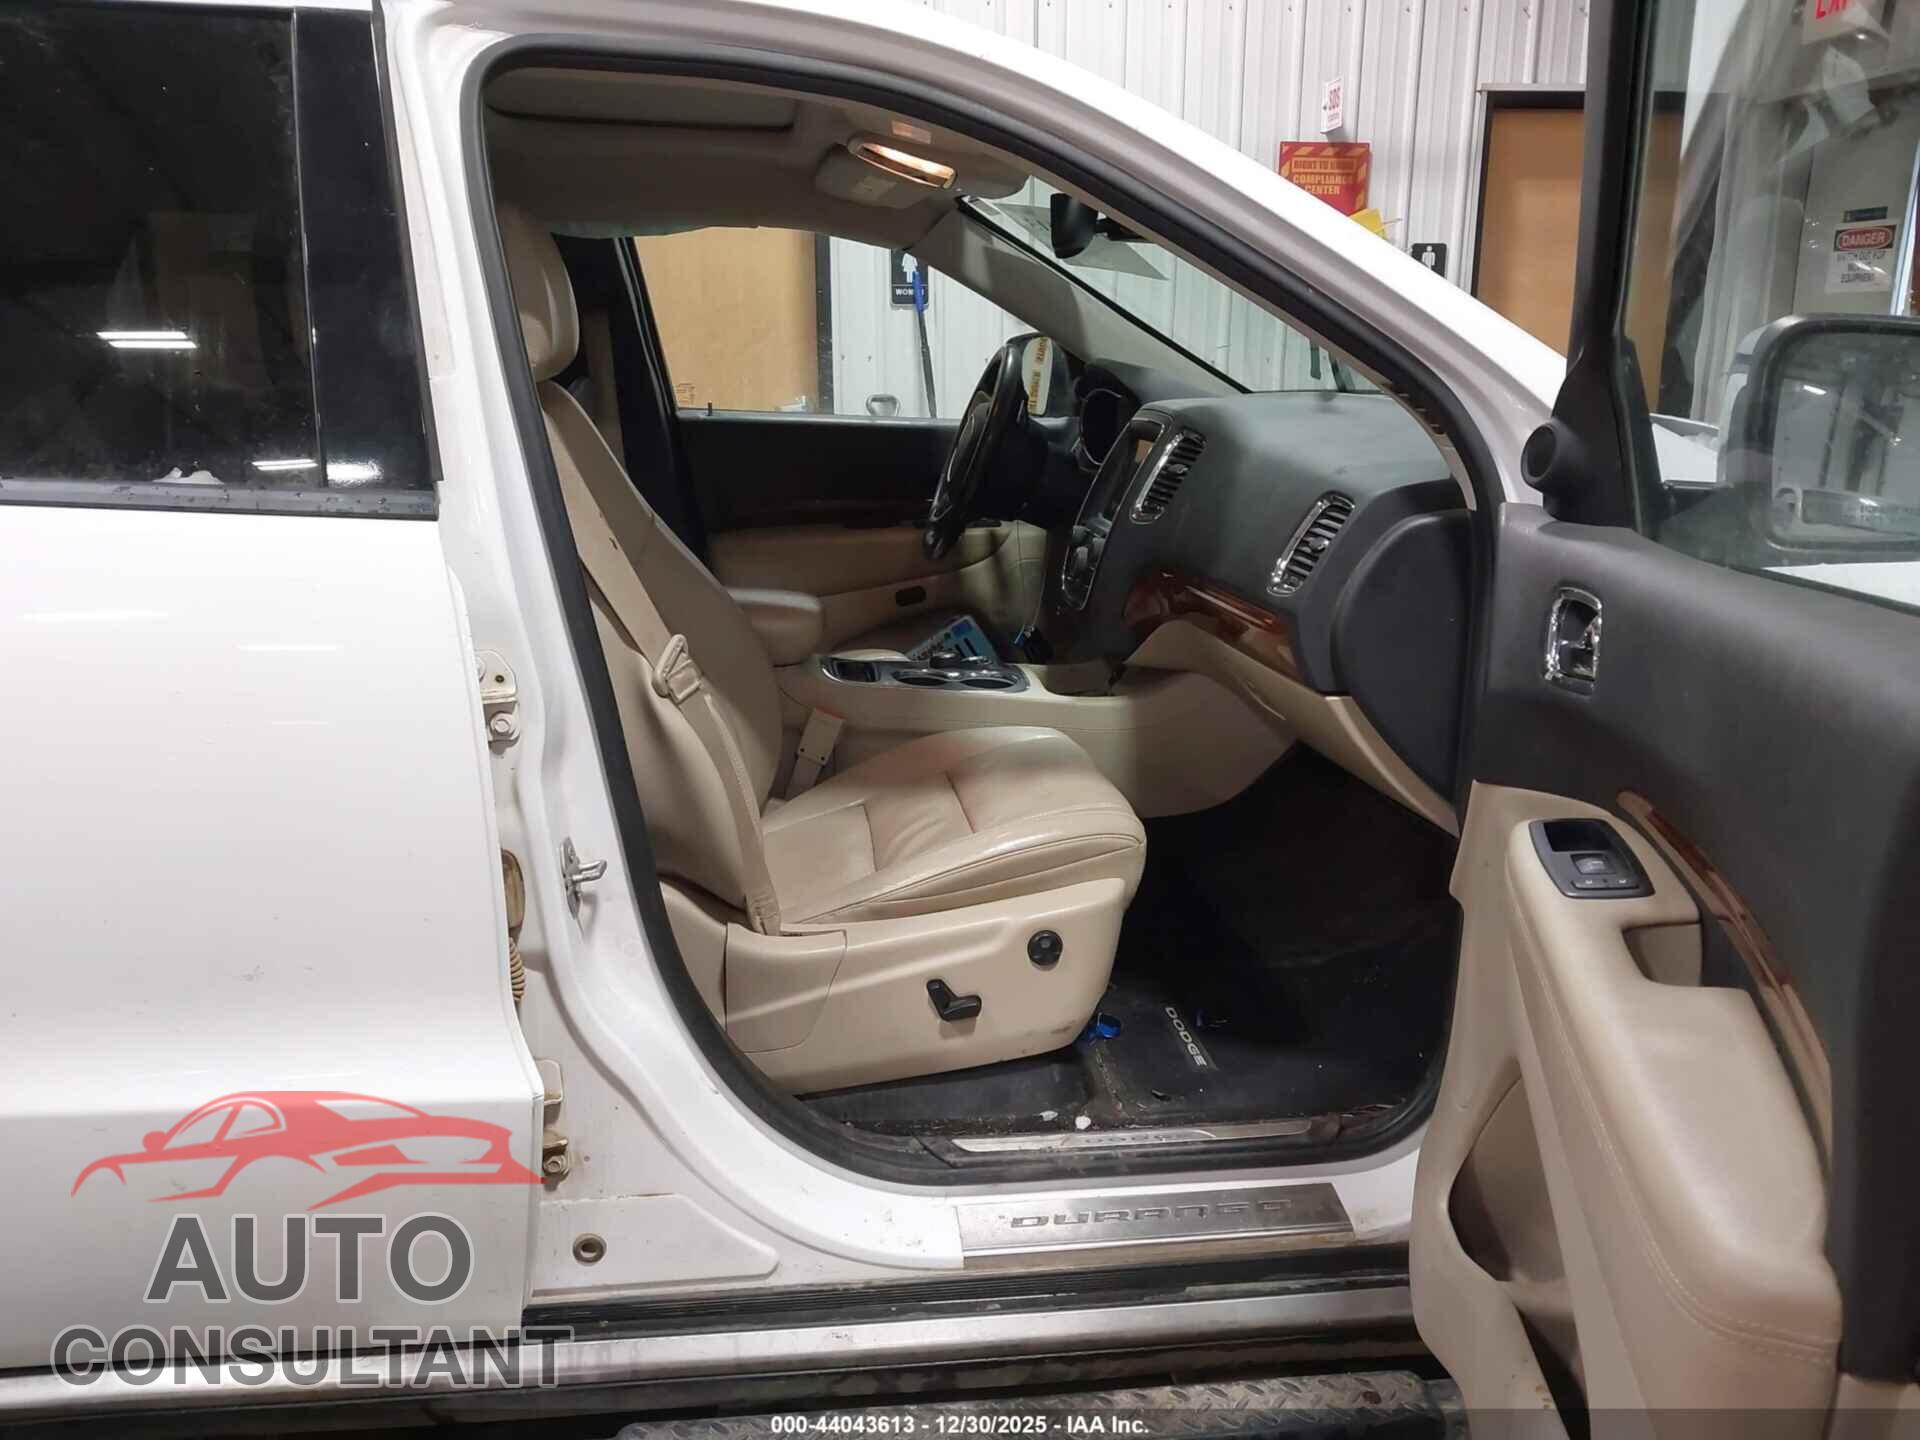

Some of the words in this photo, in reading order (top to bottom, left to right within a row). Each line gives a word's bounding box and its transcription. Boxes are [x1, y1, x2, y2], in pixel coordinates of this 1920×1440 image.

[1305, 184, 1341, 196] CENTER
[1842, 231, 1886, 248] DANGER
[895, 287, 925, 297] WOM
[1164, 1006, 1207, 1067] DODGE
[1010, 1200, 1292, 1228] DURANGO
